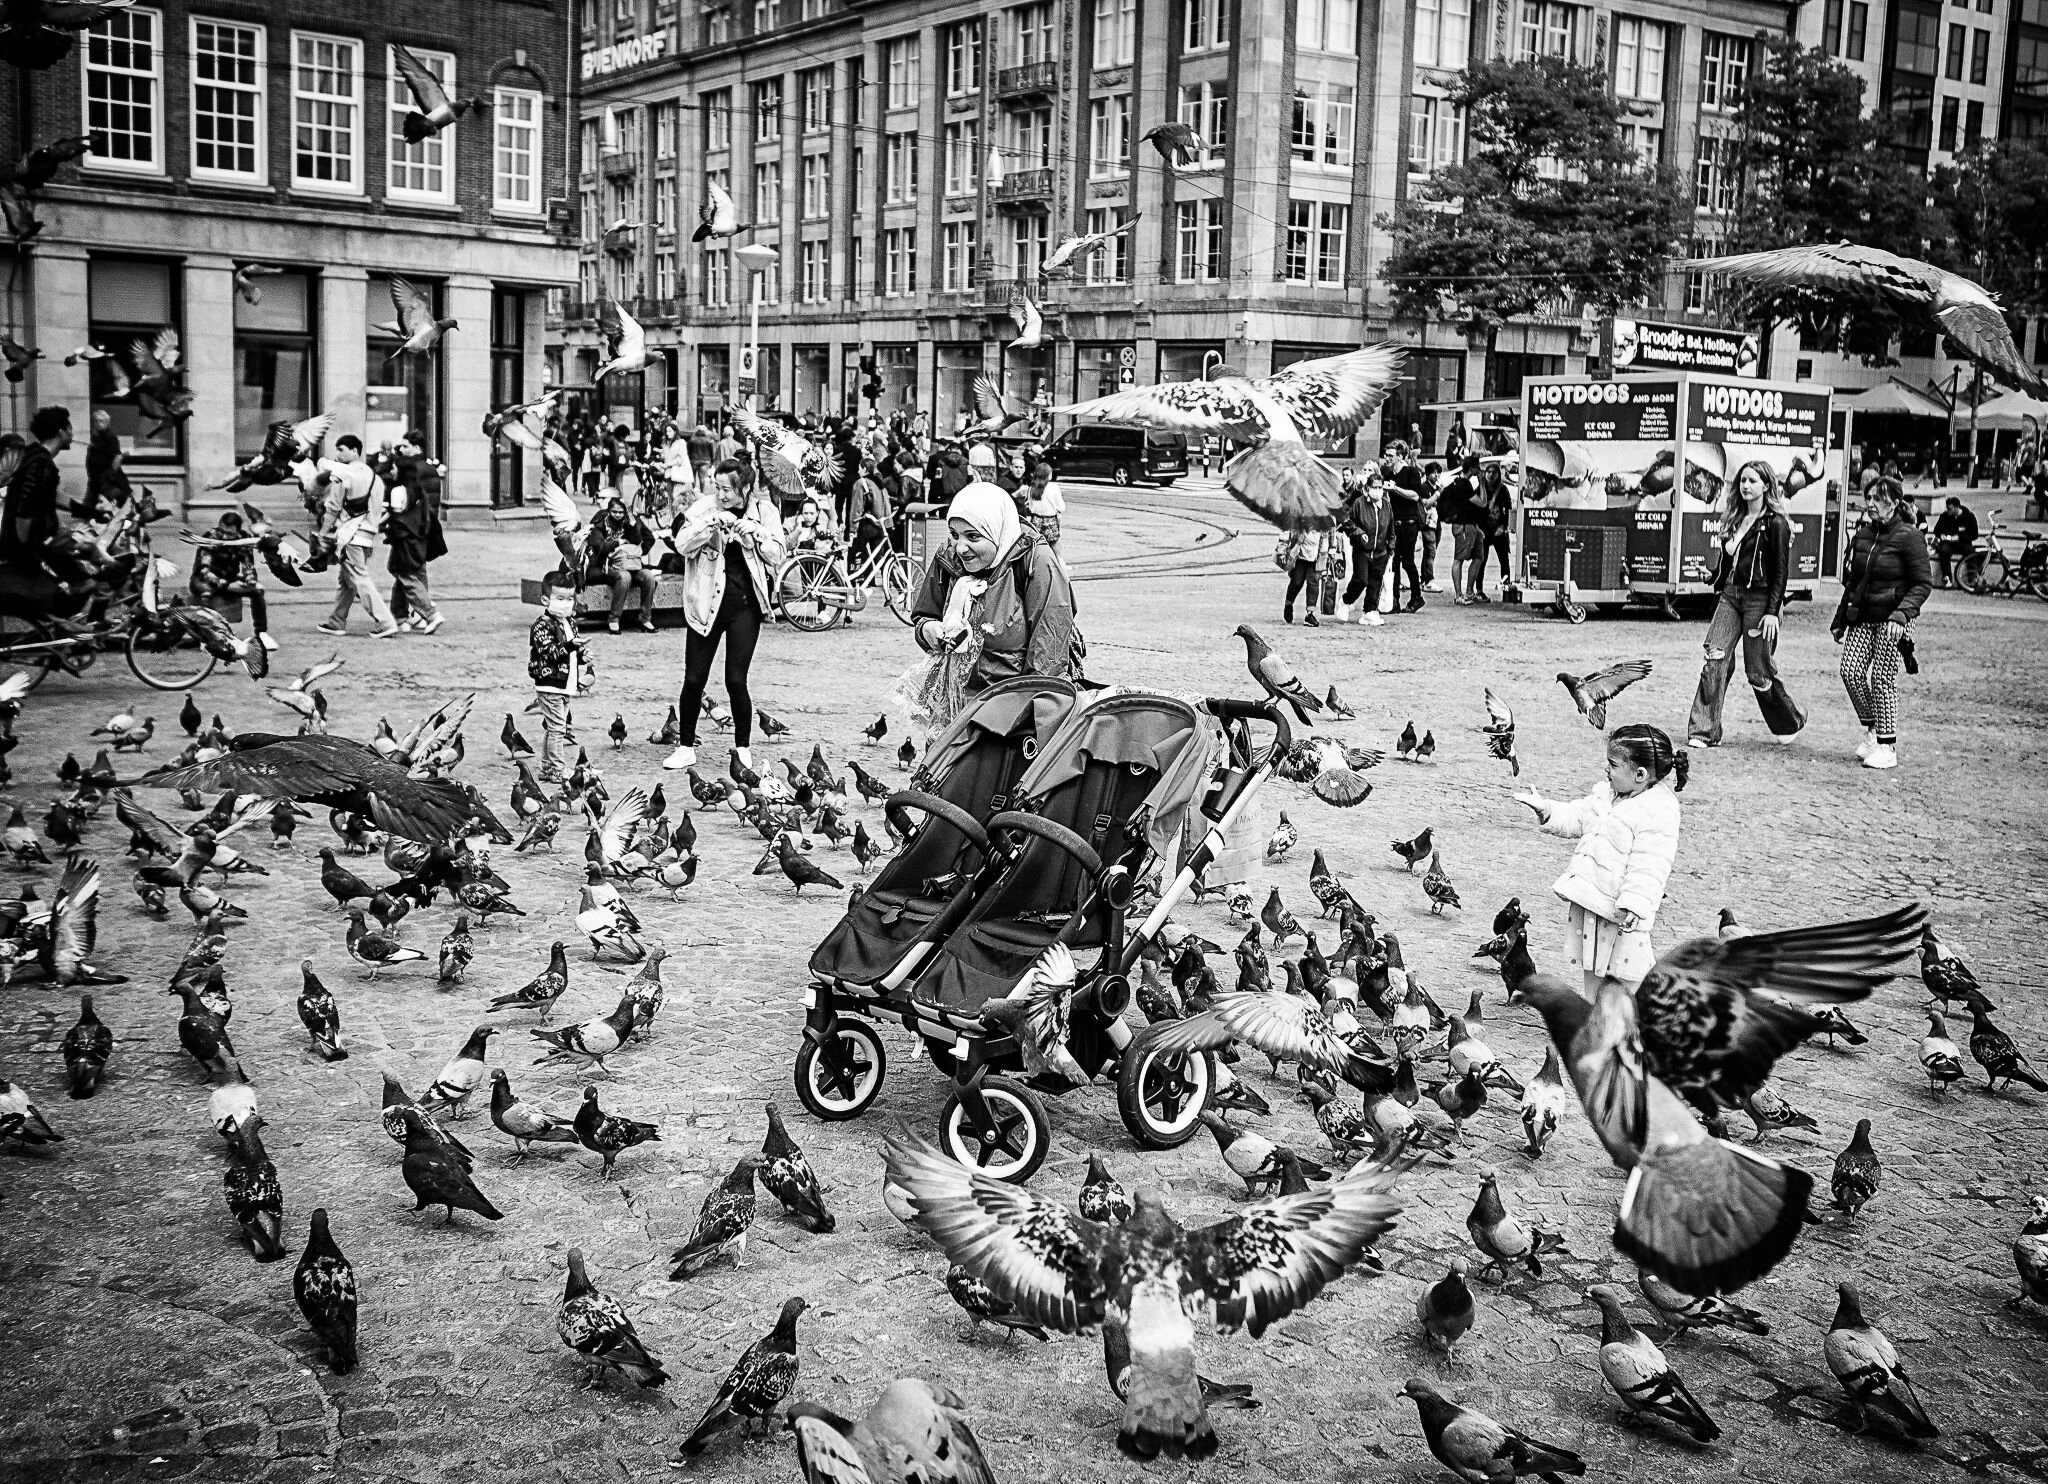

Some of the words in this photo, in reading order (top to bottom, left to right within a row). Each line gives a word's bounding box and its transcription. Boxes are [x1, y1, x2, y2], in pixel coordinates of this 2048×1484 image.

[1640, 326, 1685, 349] Broodje
[1704, 337, 1738, 355] HotDog,
[1643, 345, 1695, 365] Hamburger,
[1696, 350, 1734, 367] Beenham
[1533, 384, 1630, 405] HOTDOGS
[1633, 394, 1650, 403] AND
[1652, 393, 1675, 403] MORE
[1703, 386, 1783, 418] HOTDOGS
[1785, 408, 1797, 420] AND
[1799, 409, 1815, 421] MORE
[1584, 422, 1596, 430] ICE
[1597, 421, 1616, 430] COLD
[1586, 430, 1613, 439] DRINKS
[1528, 509, 1539, 518] ICE
[1541, 510, 1558, 518] COLD
[1634, 512, 1646, 521] ICE
[1648, 512, 1667, 522] COLD
[1530, 518, 1555, 527] DRINKS
[1637, 521, 1664, 530] DRINKS
